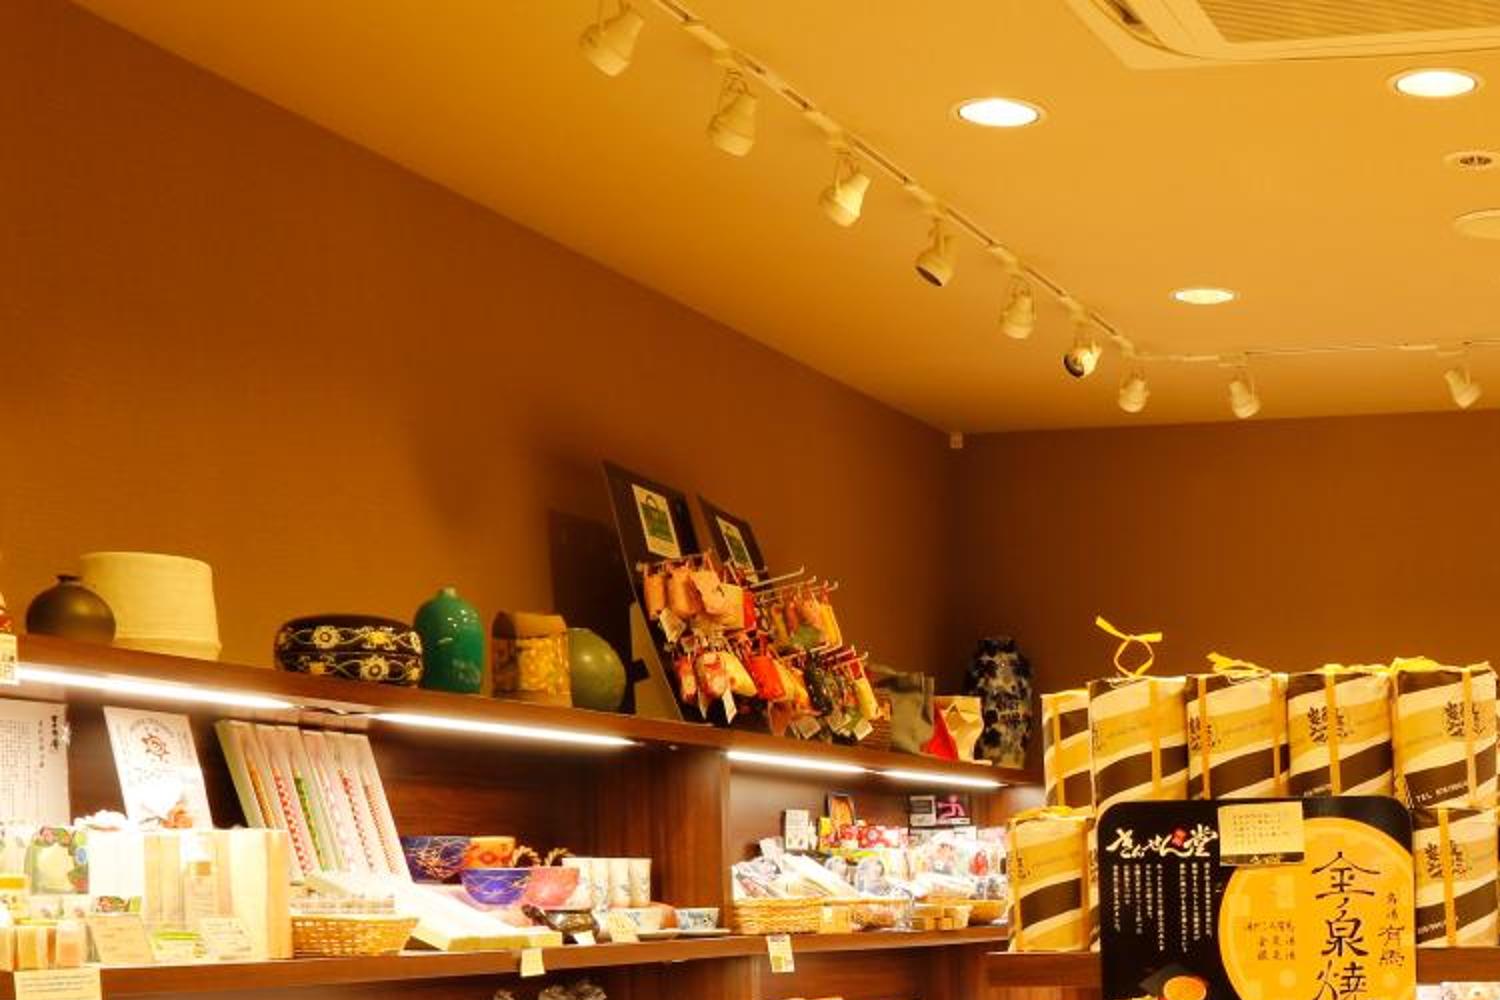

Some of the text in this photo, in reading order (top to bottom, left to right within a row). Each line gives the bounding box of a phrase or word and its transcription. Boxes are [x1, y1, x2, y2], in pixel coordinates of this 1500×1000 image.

[1106, 823, 1219, 859] きんせん堂
